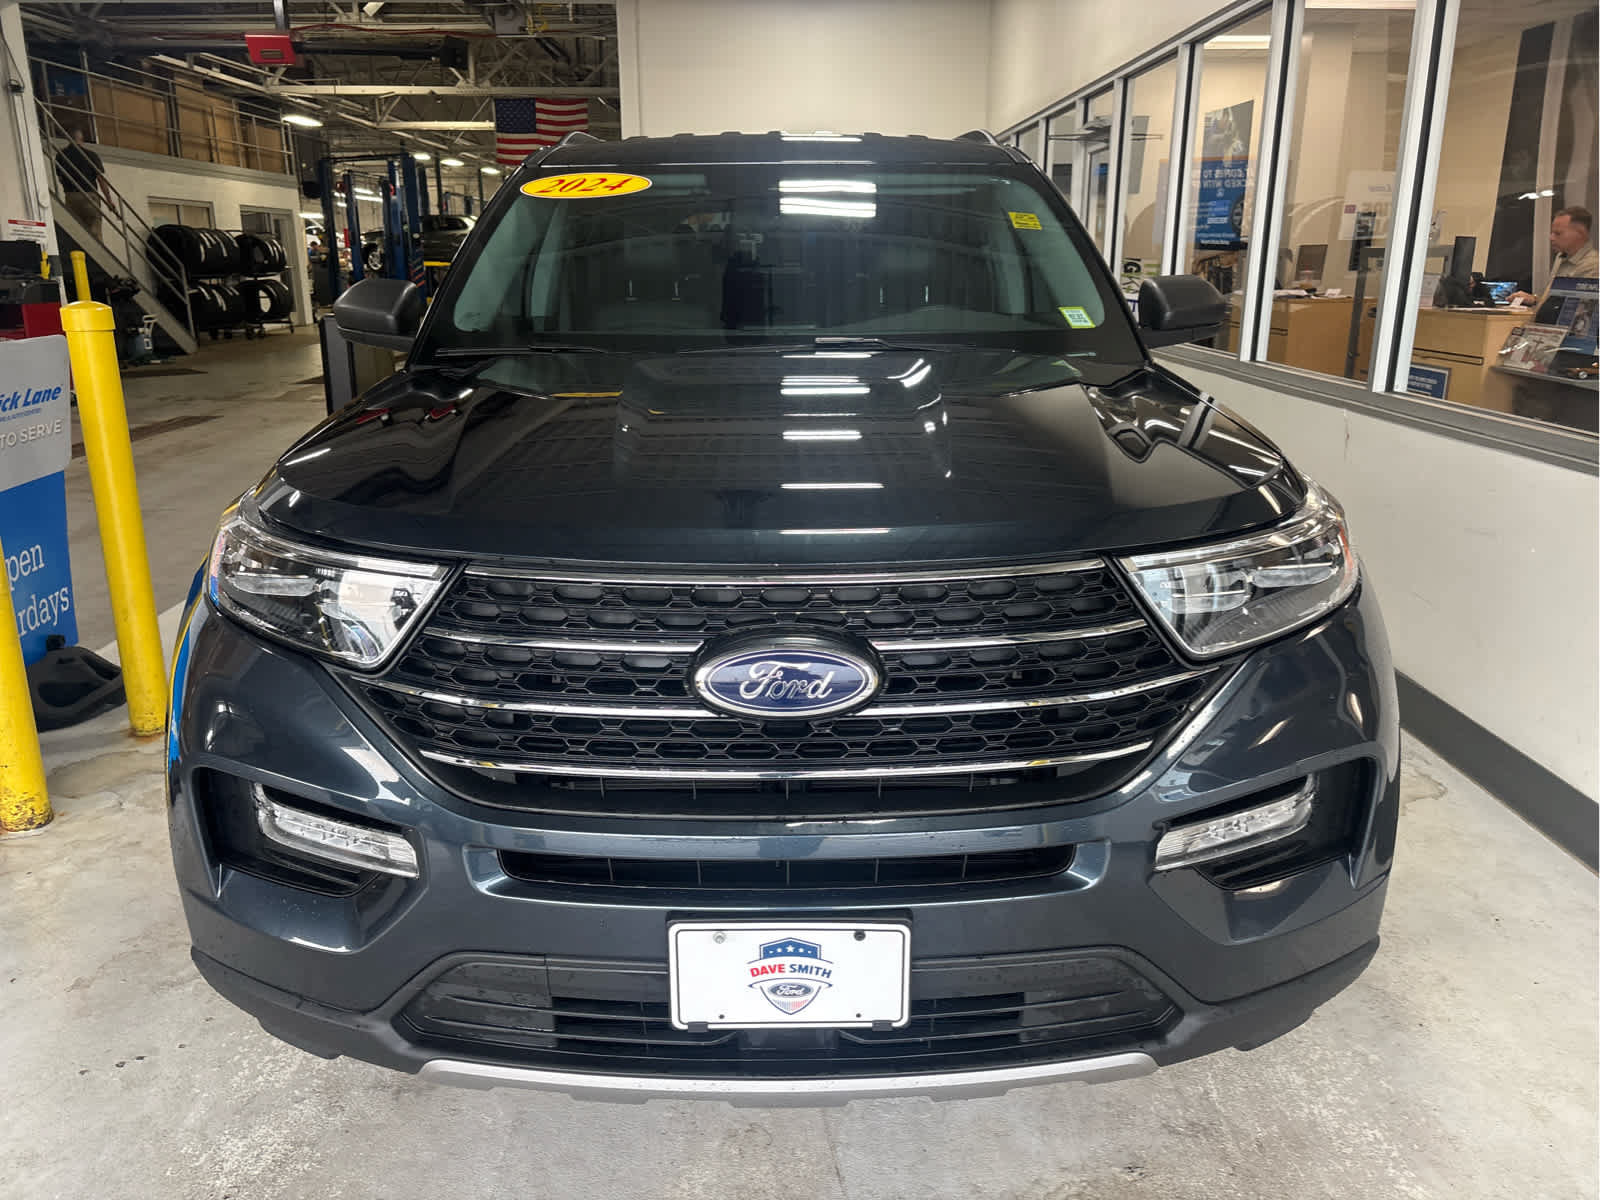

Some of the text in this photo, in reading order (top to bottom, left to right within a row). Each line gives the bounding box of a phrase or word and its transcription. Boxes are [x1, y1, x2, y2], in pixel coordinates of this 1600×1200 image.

[535, 178, 633, 193] 2024
[22, 386, 62, 407] Lane
[20, 419, 62, 442] SERVE
[739, 660, 835, 700] Ford
[750, 963, 832, 978] DAVE SMITH
[776, 984, 806, 997] Ford
